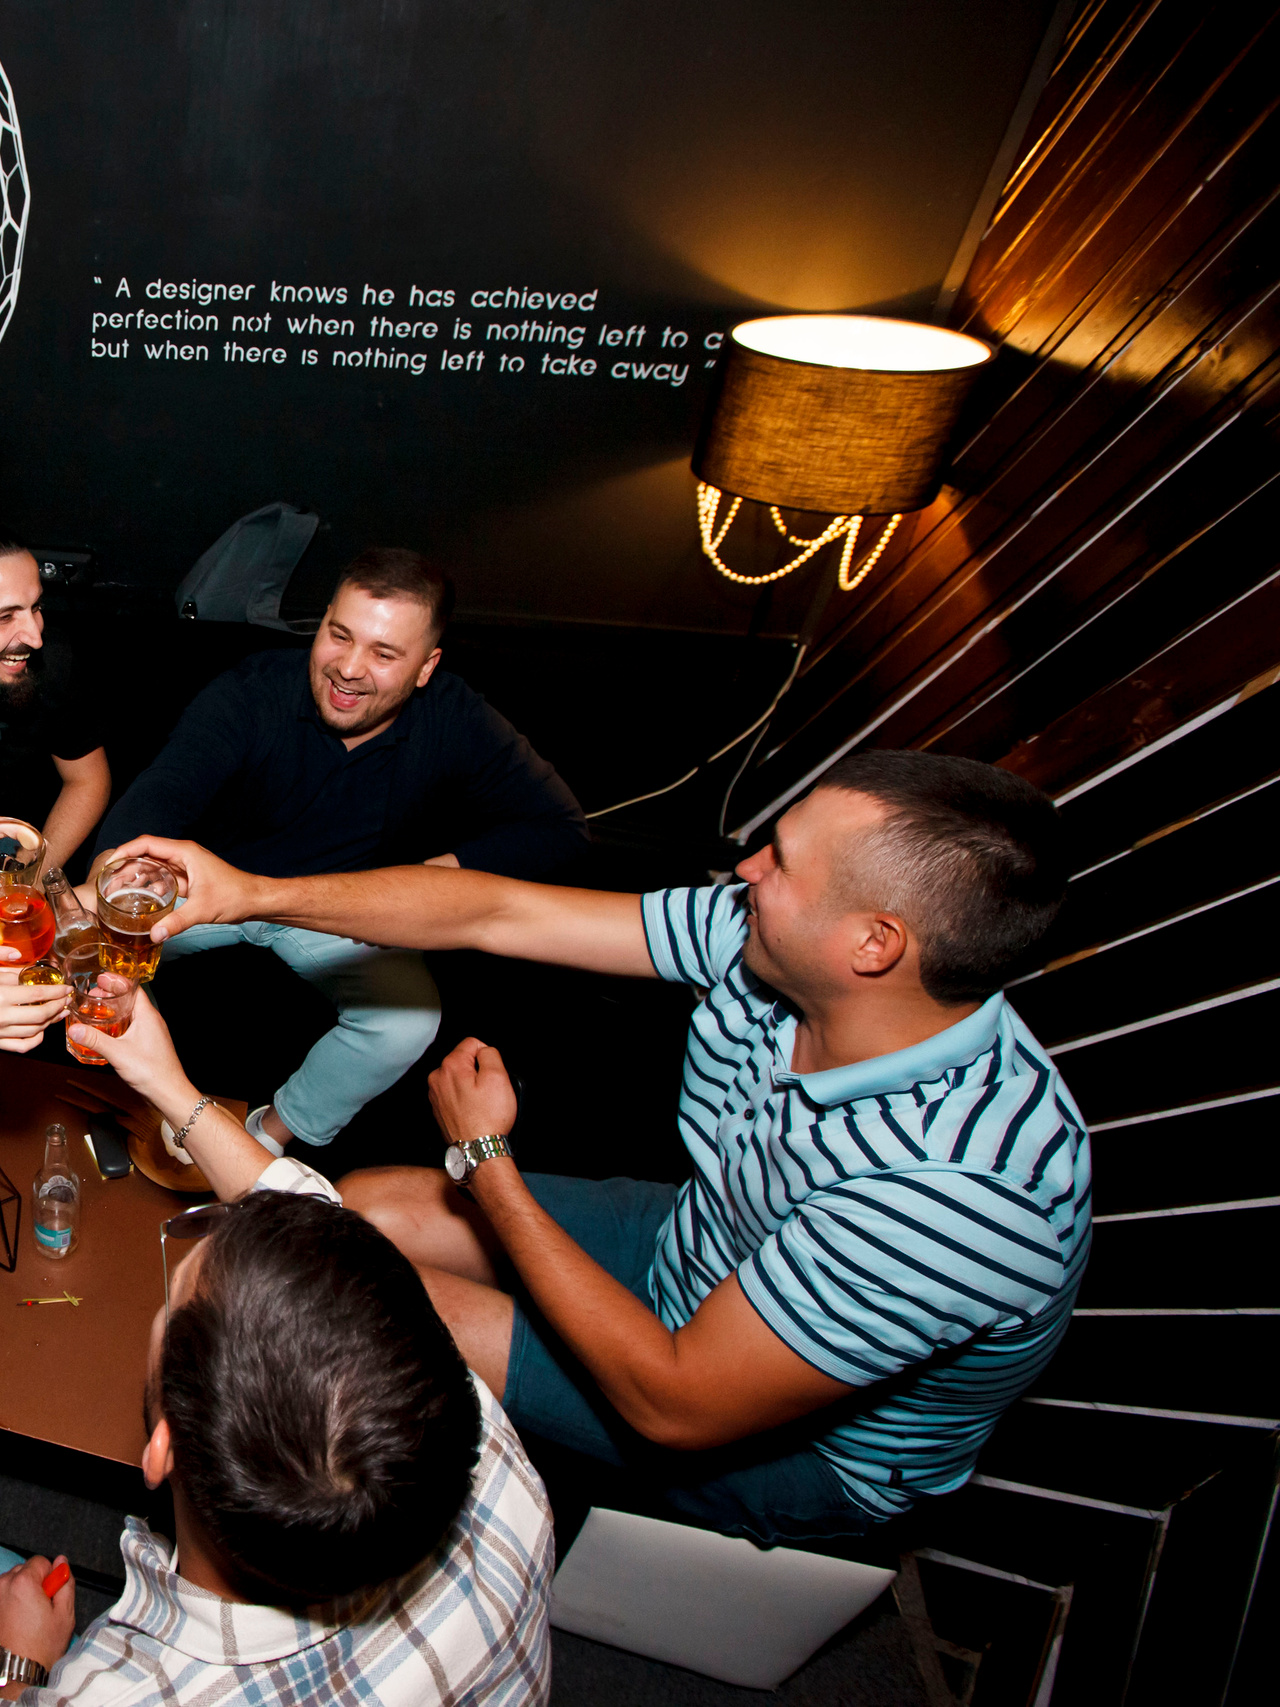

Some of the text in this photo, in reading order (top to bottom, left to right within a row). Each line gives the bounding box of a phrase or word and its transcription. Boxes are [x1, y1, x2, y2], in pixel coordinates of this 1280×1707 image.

[115, 277, 131, 298] A
[145, 278, 256, 306] designer
[270, 280, 348, 304] knows
[362, 283, 395, 306] he
[409, 284, 456, 307] has
[470, 286, 598, 311] achieved
[92, 308, 219, 333] perfection
[232, 312, 272, 333] not
[286, 313, 355, 336] when
[370, 316, 439, 339] there
[453, 317, 472, 340] is
[486, 320, 586, 349] nothing
[598, 324, 647, 347] left
[662, 326, 689, 348] to
[91, 337, 130, 359] but
[143, 339, 209, 361] when
[223, 341, 287, 364] there
[301, 349, 319, 365] is
[332, 347, 427, 375] nothing
[440, 349, 486, 371] left
[499, 353, 525, 372] to
[541, 352, 597, 376] take
[611, 361, 689, 387] away
